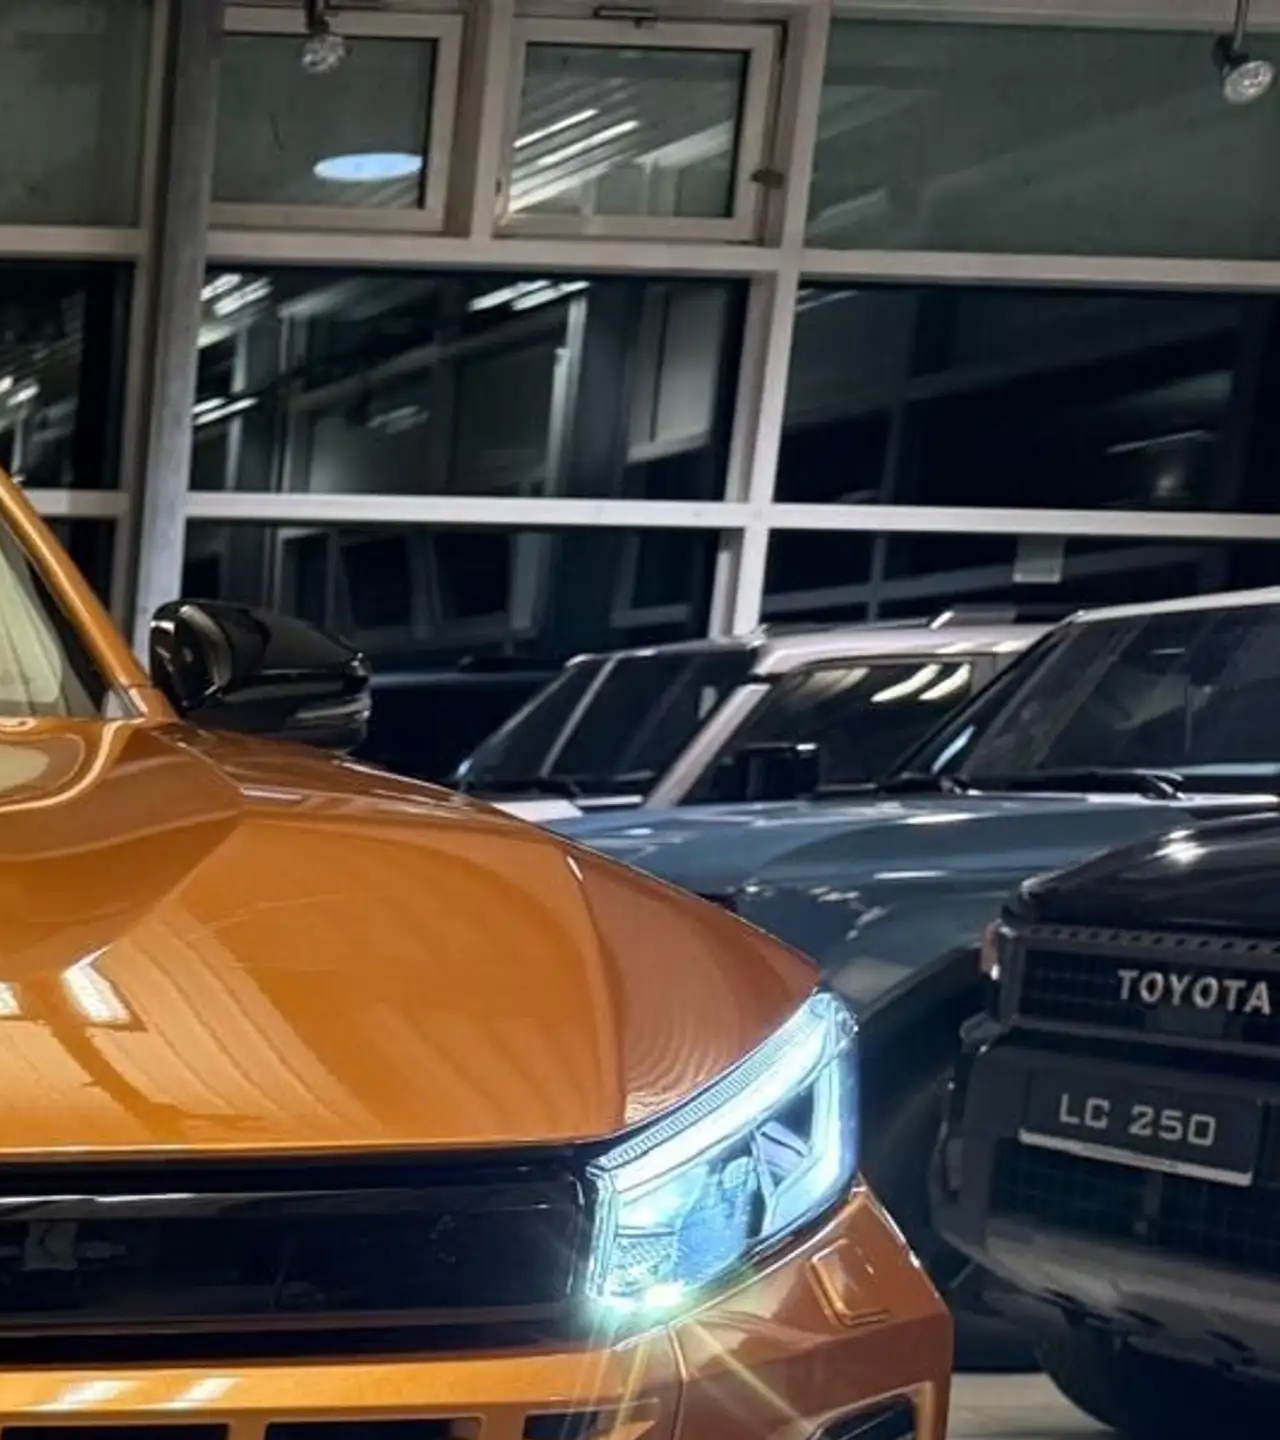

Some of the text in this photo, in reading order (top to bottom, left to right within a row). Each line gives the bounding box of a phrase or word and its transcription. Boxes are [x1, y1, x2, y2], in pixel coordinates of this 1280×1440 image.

[1117, 969, 1272, 1016] TOYOTA
[1058, 1093, 1216, 1147] LC 250
